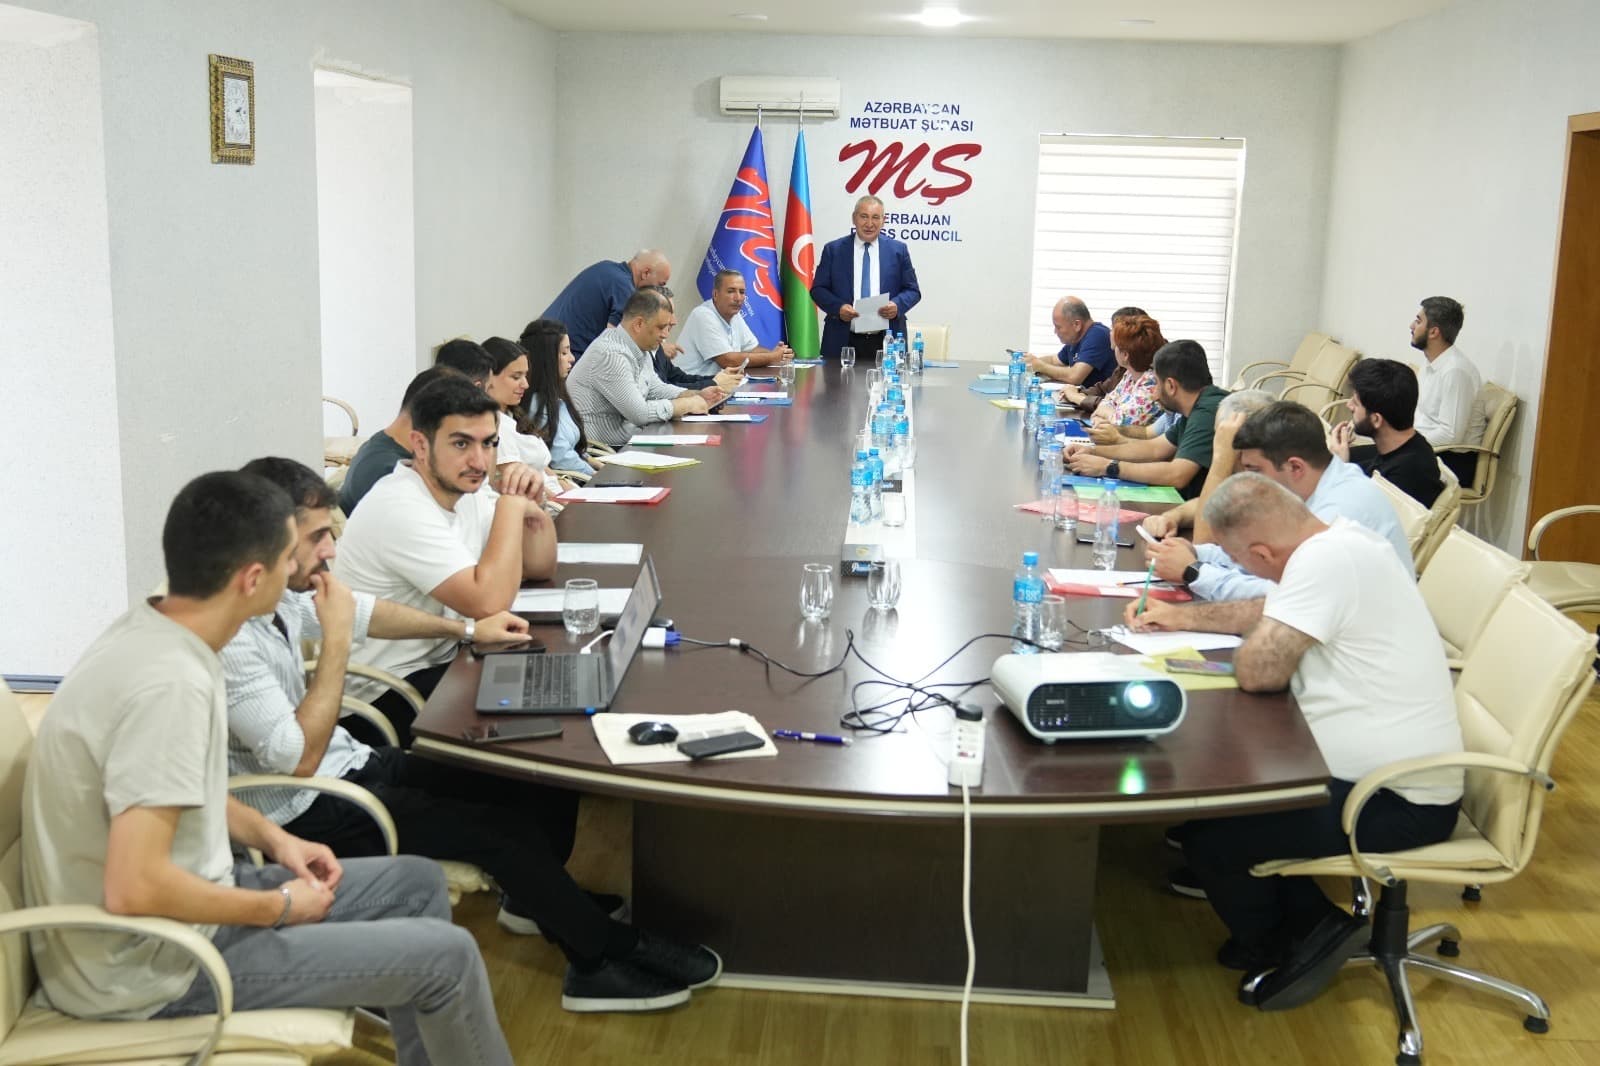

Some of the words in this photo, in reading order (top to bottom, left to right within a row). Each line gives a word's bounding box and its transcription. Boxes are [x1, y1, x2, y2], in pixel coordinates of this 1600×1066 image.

[850, 117, 918, 130] MƏTBUAT
[882, 212, 951, 226] ERBAIJAN
[900, 229, 963, 242] COUNCIL
